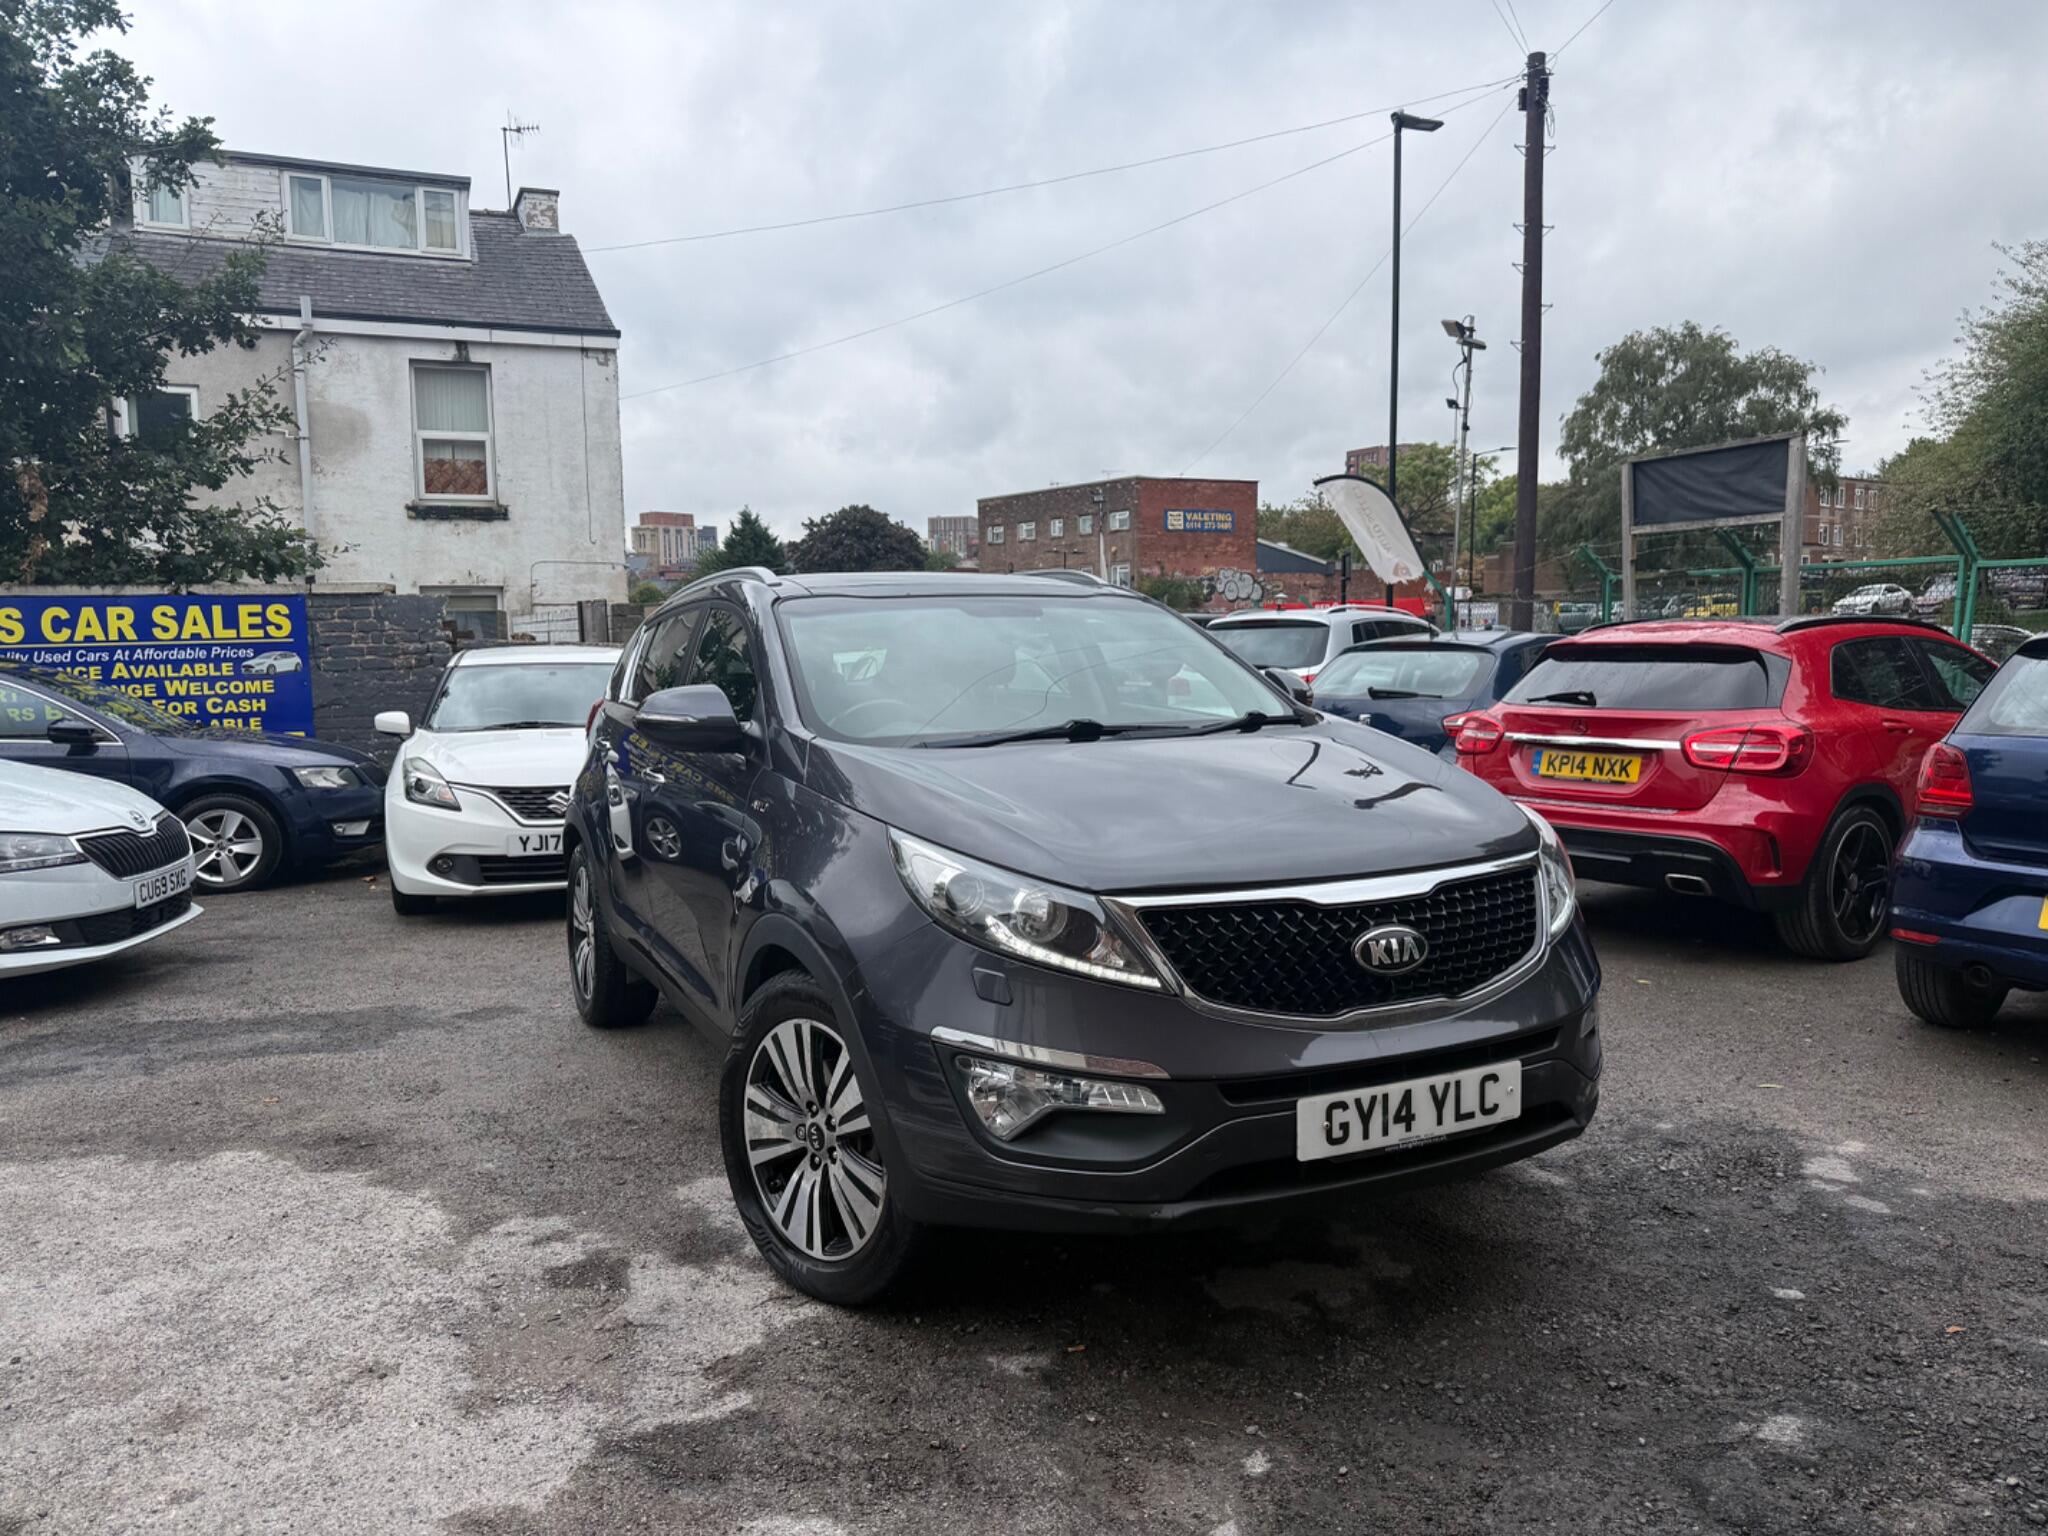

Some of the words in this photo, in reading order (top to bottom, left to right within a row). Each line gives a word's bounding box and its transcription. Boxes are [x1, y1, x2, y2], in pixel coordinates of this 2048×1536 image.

[1185, 511, 1232, 522] VALETING
[41, 606, 135, 642] CAR
[152, 603, 293, 640] SALES
[33, 650, 72, 663] Used
[75, 649, 110, 662] Cars
[113, 648, 131, 661] At
[132, 647, 207, 660] Affordable
[210, 646, 255, 659] Prices
[111, 662, 234, 679] AVAILABLE
[164, 679, 275, 696] WELCOME
[206, 697, 267, 714] CASH
[1546, 753, 1587, 775] KP14
[1592, 757, 1633, 778] NXK
[519, 834, 561, 852] YJ17
[140, 876, 168, 902] CU69
[169, 868, 187, 892] SXG
[1368, 936, 1420, 965] KIA
[1325, 1088, 1416, 1146] GY14
[1429, 1073, 1500, 1127] YLC
